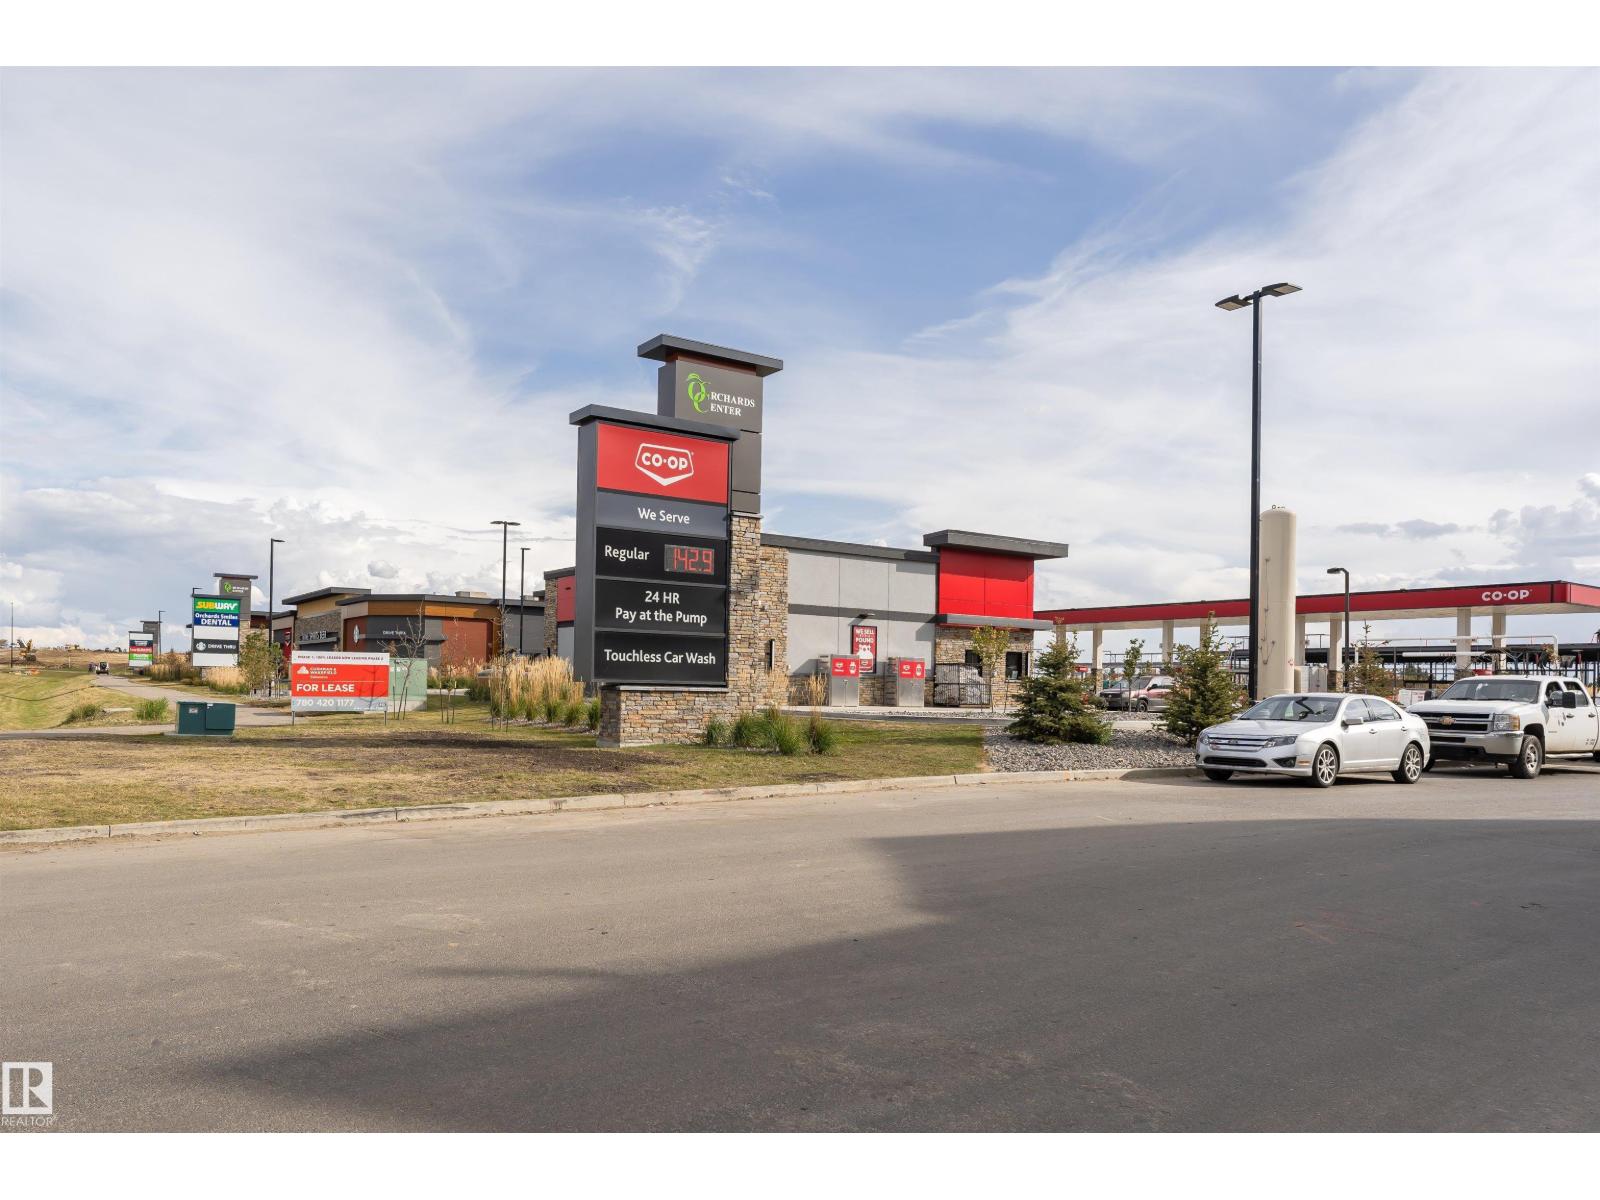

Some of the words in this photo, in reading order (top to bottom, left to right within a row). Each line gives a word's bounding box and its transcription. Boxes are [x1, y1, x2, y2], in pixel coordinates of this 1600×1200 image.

[641, 452, 688, 471] CO-OP
[638, 507, 656, 521] We
[659, 510, 690, 524] Serve
[604, 545, 650, 562] Regular
[673, 547, 714, 574] 142.9
[645, 590, 660, 603] 24
[663, 591, 680, 604] HR
[1481, 589, 1530, 601] CO-OP
[195, 601, 238, 610] SUBWAY
[200, 618, 232, 626] DENTAL
[615, 607, 636, 623] Pay
[639, 610, 652, 621] at
[654, 609, 673, 622] the
[675, 611, 707, 627] Pump
[604, 648, 662, 663] Touchless
[664, 651, 683, 664] Car
[685, 652, 716, 665] Wash
[296, 683, 318, 692] FOR
[321, 684, 355, 692] LEASE
[296, 698, 314, 707] 780
[316, 699, 335, 707] 420
[337, 699, 354, 707] 1177
